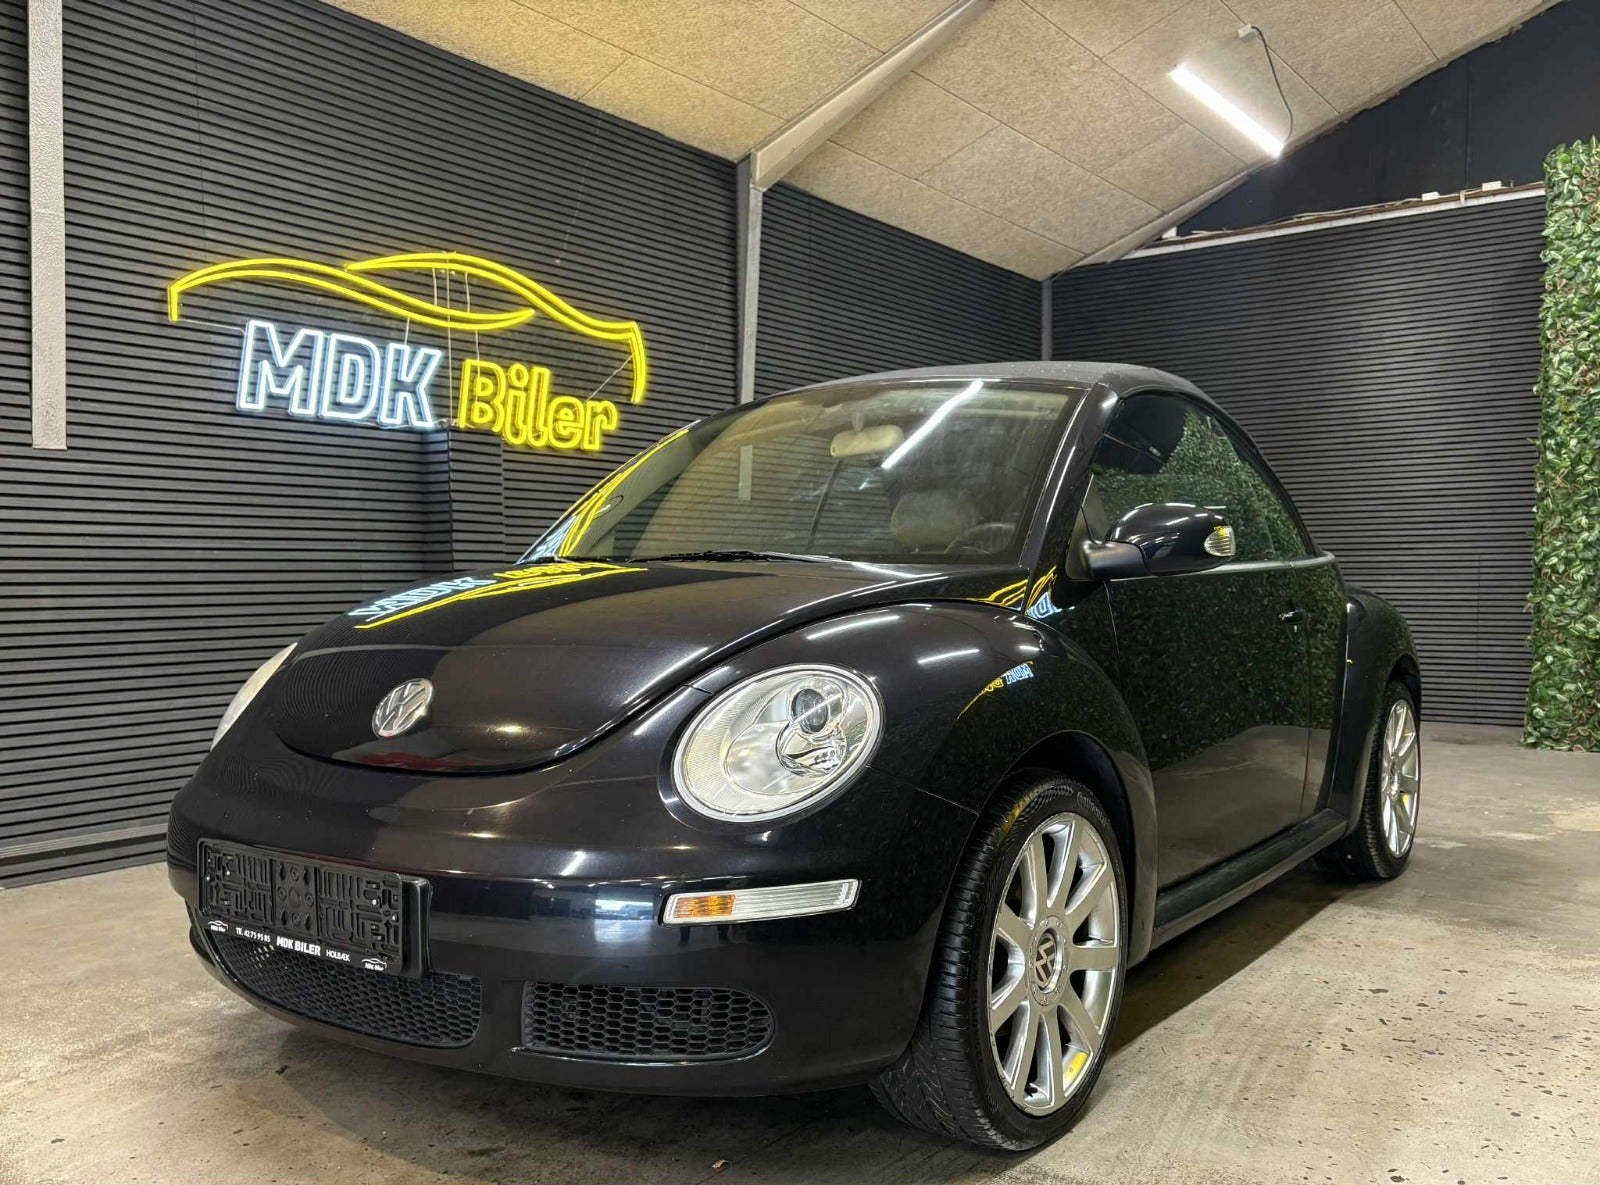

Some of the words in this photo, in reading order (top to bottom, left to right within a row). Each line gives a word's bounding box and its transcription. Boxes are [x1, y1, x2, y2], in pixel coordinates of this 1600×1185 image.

[236, 319, 443, 430] MDK
[457, 358, 618, 451] Biler
[372, 678, 433, 737] VW
[276, 935, 294, 950] MDK
[294, 940, 321, 957] BILER
